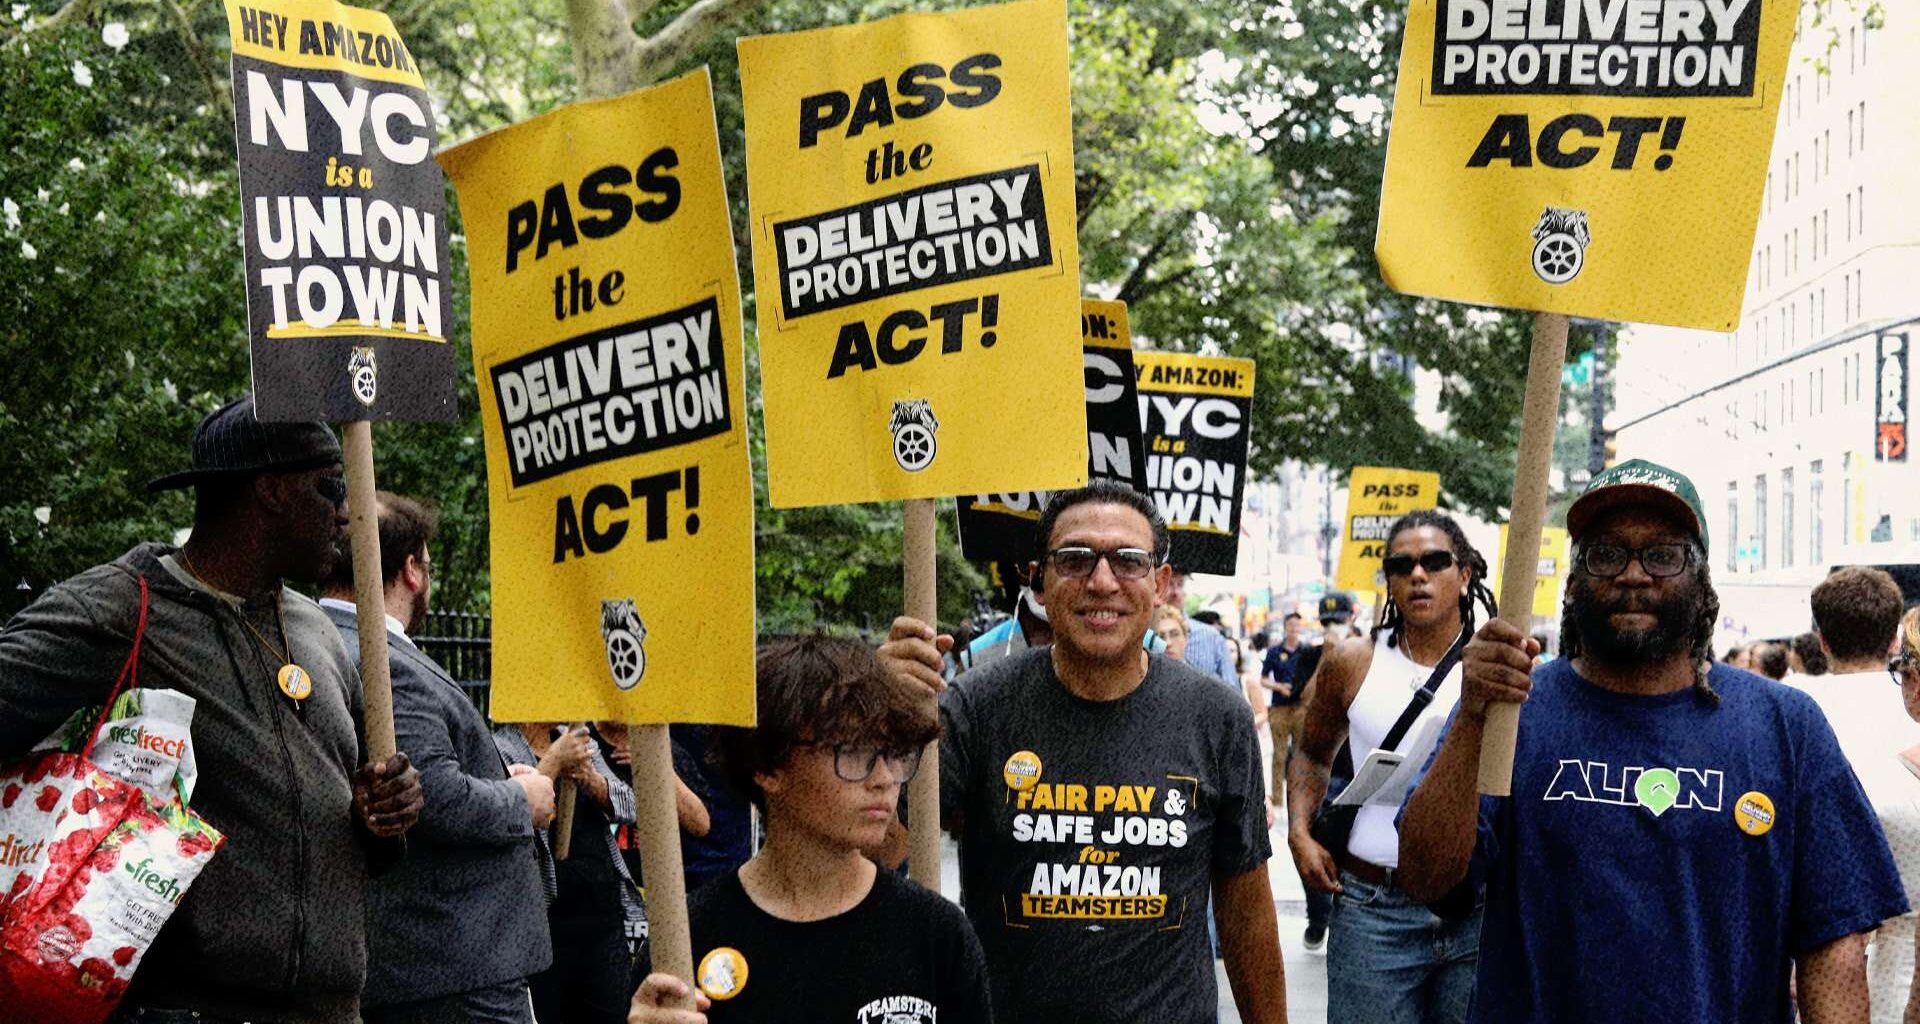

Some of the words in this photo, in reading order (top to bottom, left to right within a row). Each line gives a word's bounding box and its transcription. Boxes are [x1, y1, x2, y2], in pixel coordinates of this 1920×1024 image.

[239, 6, 288, 51] HEY
[1445, 0, 1749, 43] DELIVERY
[1442, 44, 1744, 88] PROTECTION
[246, 70, 430, 165] NYC
[799, 53, 1002, 149] PASS
[864, 140, 933, 185] the
[1465, 113, 1687, 171] ACT!
[326, 157, 353, 188] is
[358, 170, 374, 189] a
[504, 146, 682, 275] PASS
[783, 173, 1030, 269] DELIVERY
[255, 196, 438, 273] UNION
[788, 219, 1040, 309] PROTECTION
[261, 265, 442, 337] TOWN
[552, 264, 625, 322] the
[827, 294, 1000, 379] ACT!
[497, 310, 713, 423] DELIVERY
[1150, 365, 1244, 390] AMAZON:
[511, 370, 724, 475] PROTECTION
[1152, 434, 1171, 452] is
[1173, 440, 1186, 453] a
[1147, 455, 1235, 497] ION
[1363, 484, 1419, 497] PASS
[553, 466, 701, 564] ACT!
[1150, 491, 1232, 533] WN
[1353, 516, 1401, 528] DELIV
[1016, 783, 1088, 812] FAIR
[1094, 785, 1157, 813] PAY
[1164, 788, 1187, 816] &
[1012, 813, 1094, 844] SAFE
[1101, 816, 1188, 848] JOBS
[1078, 845, 1120, 865] for
[1030, 862, 1161, 897] AMAZON
[1029, 897, 1162, 916] TEAMSTERS
